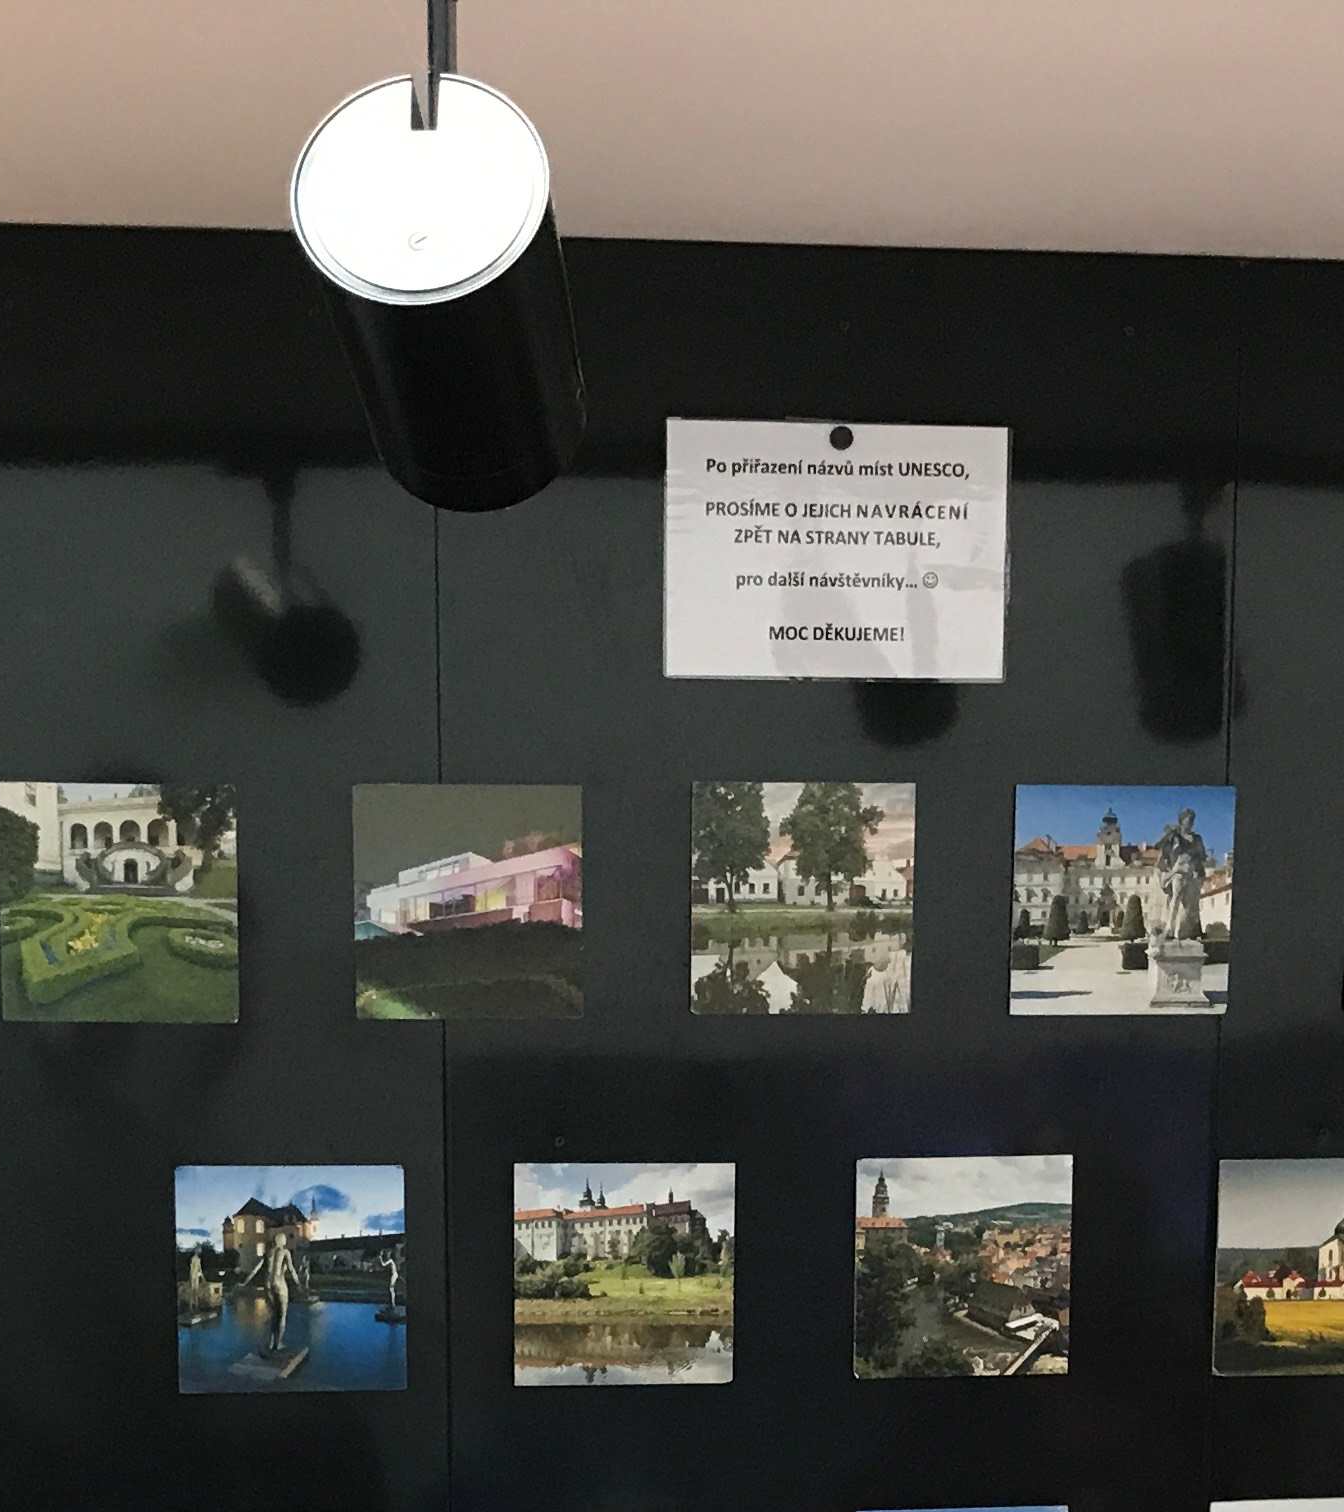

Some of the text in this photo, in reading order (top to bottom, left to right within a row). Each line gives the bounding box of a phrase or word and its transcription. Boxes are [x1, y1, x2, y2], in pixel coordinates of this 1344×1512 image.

[706, 458, 970, 480] Po přiřazení názvů míst UNESCO,
[705, 498, 780, 517] PROSÍME
[784, 502, 797, 518] O
[801, 503, 852, 518] JEJICH
[734, 524, 941, 549] ZPĚT NA STRANY TABULE,
[735, 574, 763, 590] pro
[767, 571, 805, 587] další
[769, 623, 905, 642] MOC DĚKUJEME!
